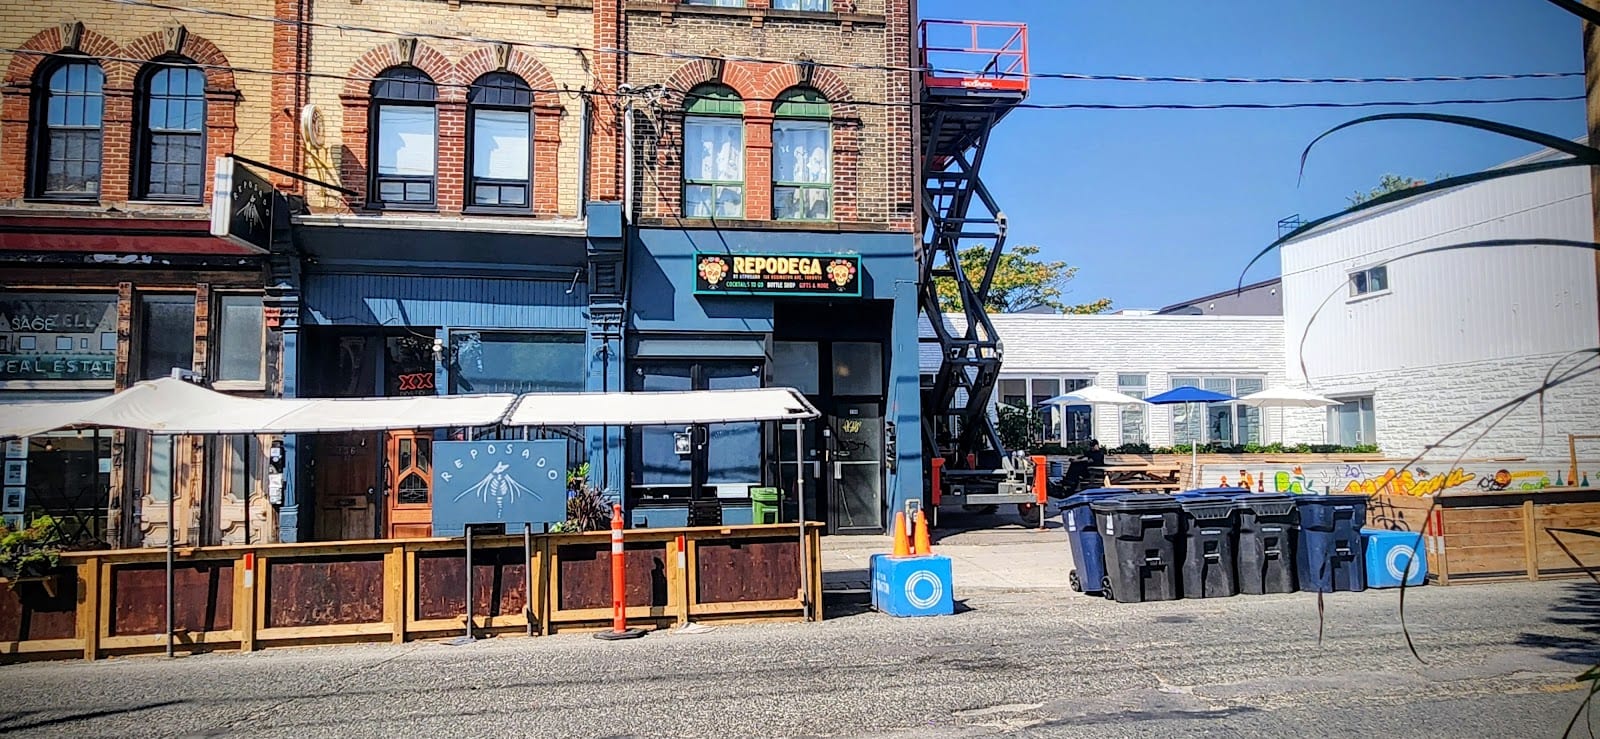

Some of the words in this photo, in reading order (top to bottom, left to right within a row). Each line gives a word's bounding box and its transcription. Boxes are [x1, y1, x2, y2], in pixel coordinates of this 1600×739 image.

[733, 257, 822, 275] REPODEGA
[11, 317, 54, 331] SAGE
[53, 360, 114, 373] ESTAT
[398, 372, 434, 391] XX
[441, 444, 558, 482] REPOSADO
